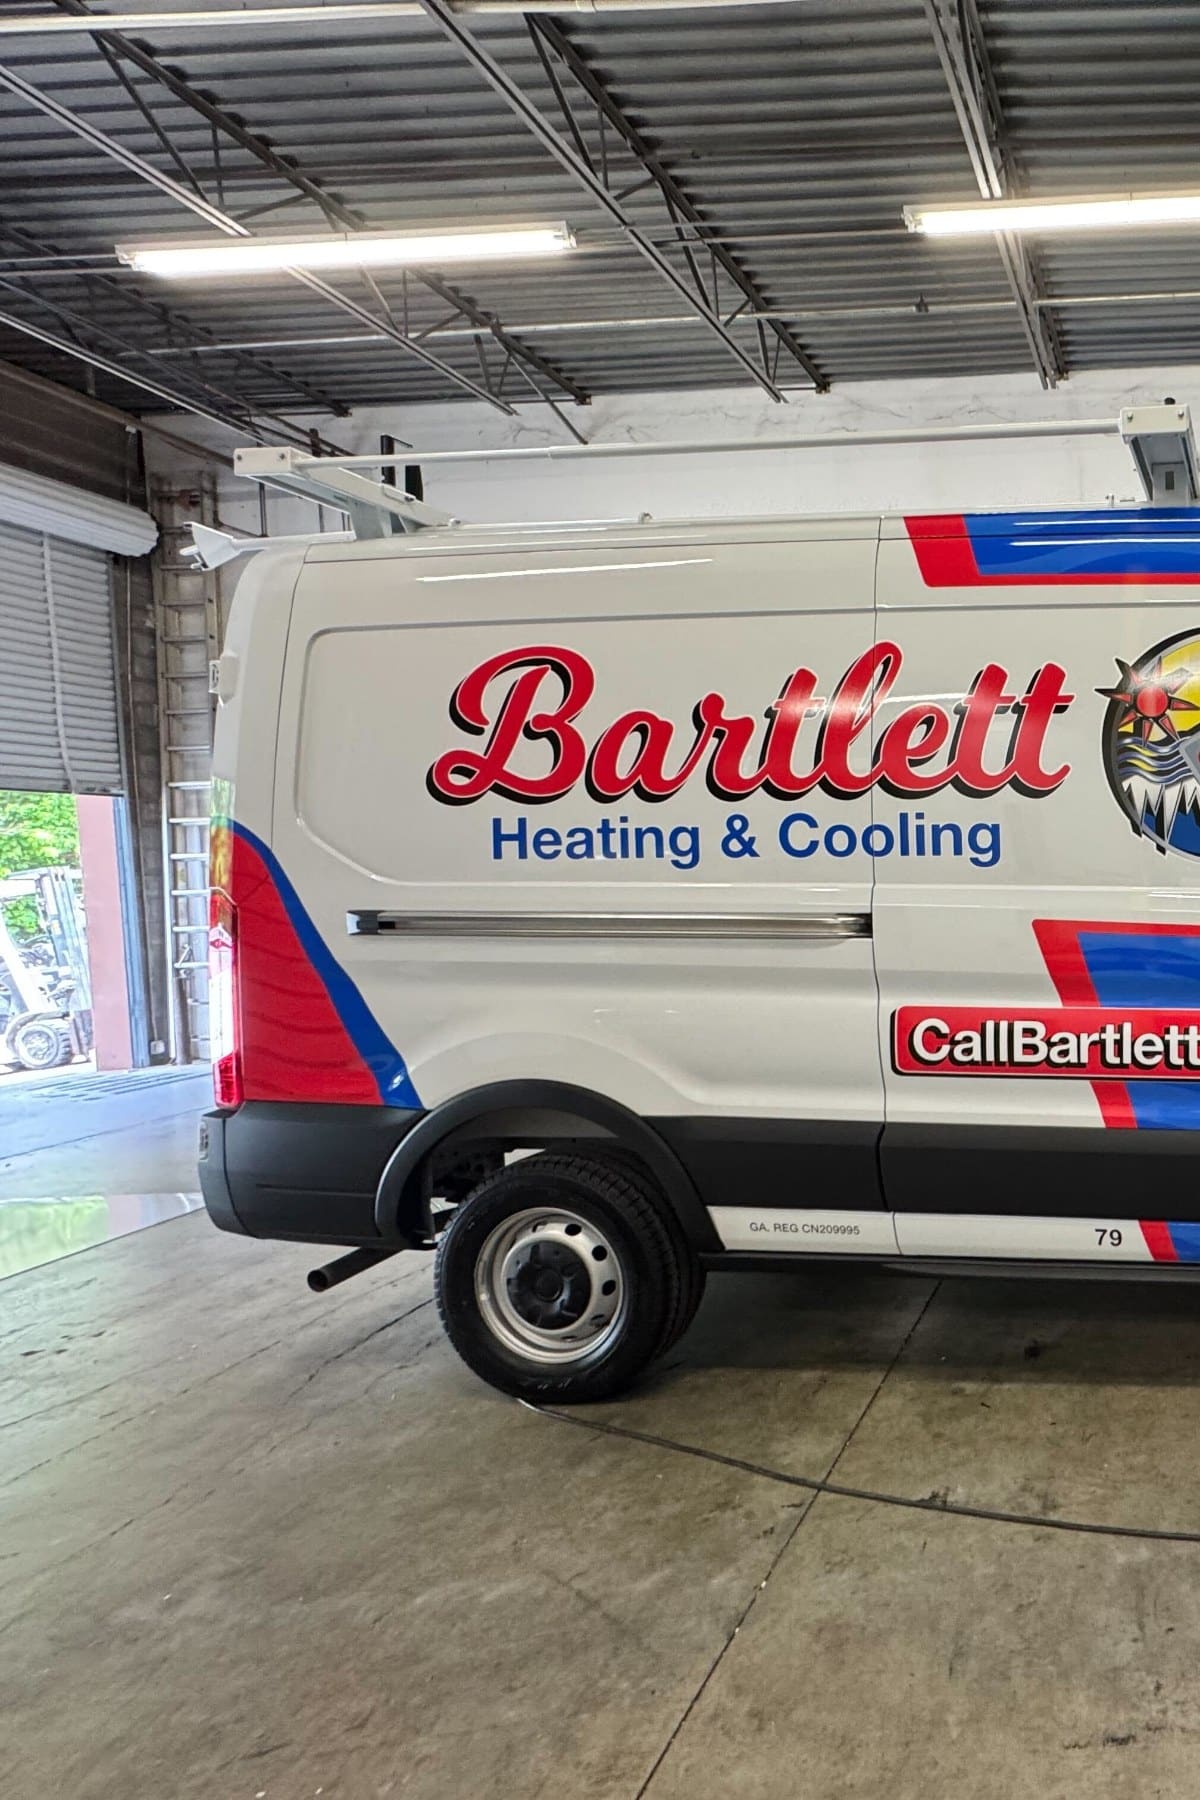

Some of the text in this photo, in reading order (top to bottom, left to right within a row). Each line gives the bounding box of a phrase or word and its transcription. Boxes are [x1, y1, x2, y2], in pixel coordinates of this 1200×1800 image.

[426, 641, 1076, 807] Bartlett
[491, 811, 1001, 870] Heating & Cooling
[748, 1222, 860, 1235] GA. REG CN209995
[1094, 1228, 1123, 1247] 79
